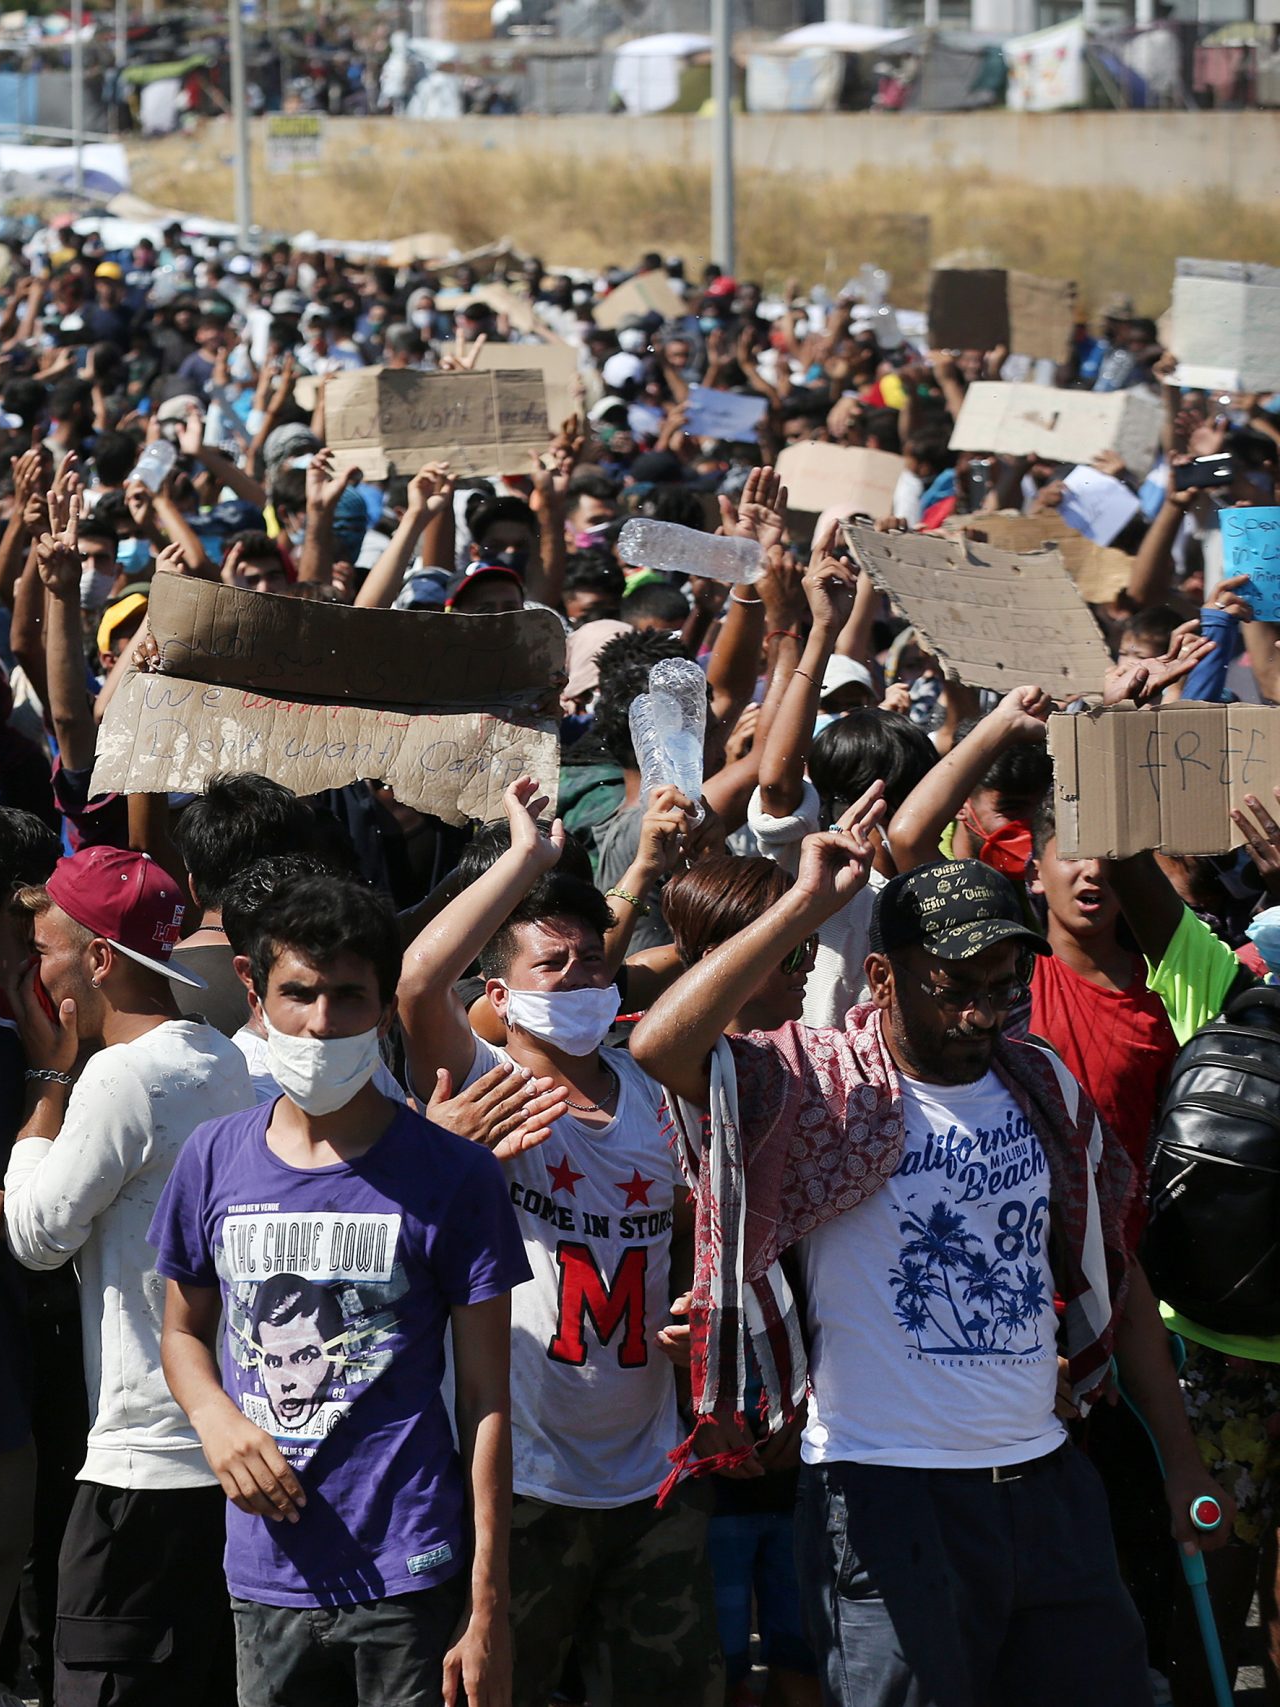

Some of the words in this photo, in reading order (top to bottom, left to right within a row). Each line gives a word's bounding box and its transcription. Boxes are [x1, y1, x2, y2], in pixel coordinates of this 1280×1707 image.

[144, 680, 223, 710] We
[285, 736, 394, 766] want
[1137, 729, 1270, 803] FREE
[889, 1110, 1038, 1180] alifornia
[954, 1137, 1047, 1205] Beach
[989, 1142, 1028, 1170] MALIBU
[247, 1203, 261, 1213] NEW
[261, 1202, 281, 1212] VENUE
[509, 1181, 576, 1232] COME
[582, 1212, 610, 1239] IN
[993, 1195, 1048, 1262] 86
[228, 1221, 258, 1274] THE
[262, 1219, 324, 1273] SHAKE
[328, 1219, 389, 1274] DOWN
[548, 1242, 649, 1369] M
[332, 1387, 347, 1400] 89
